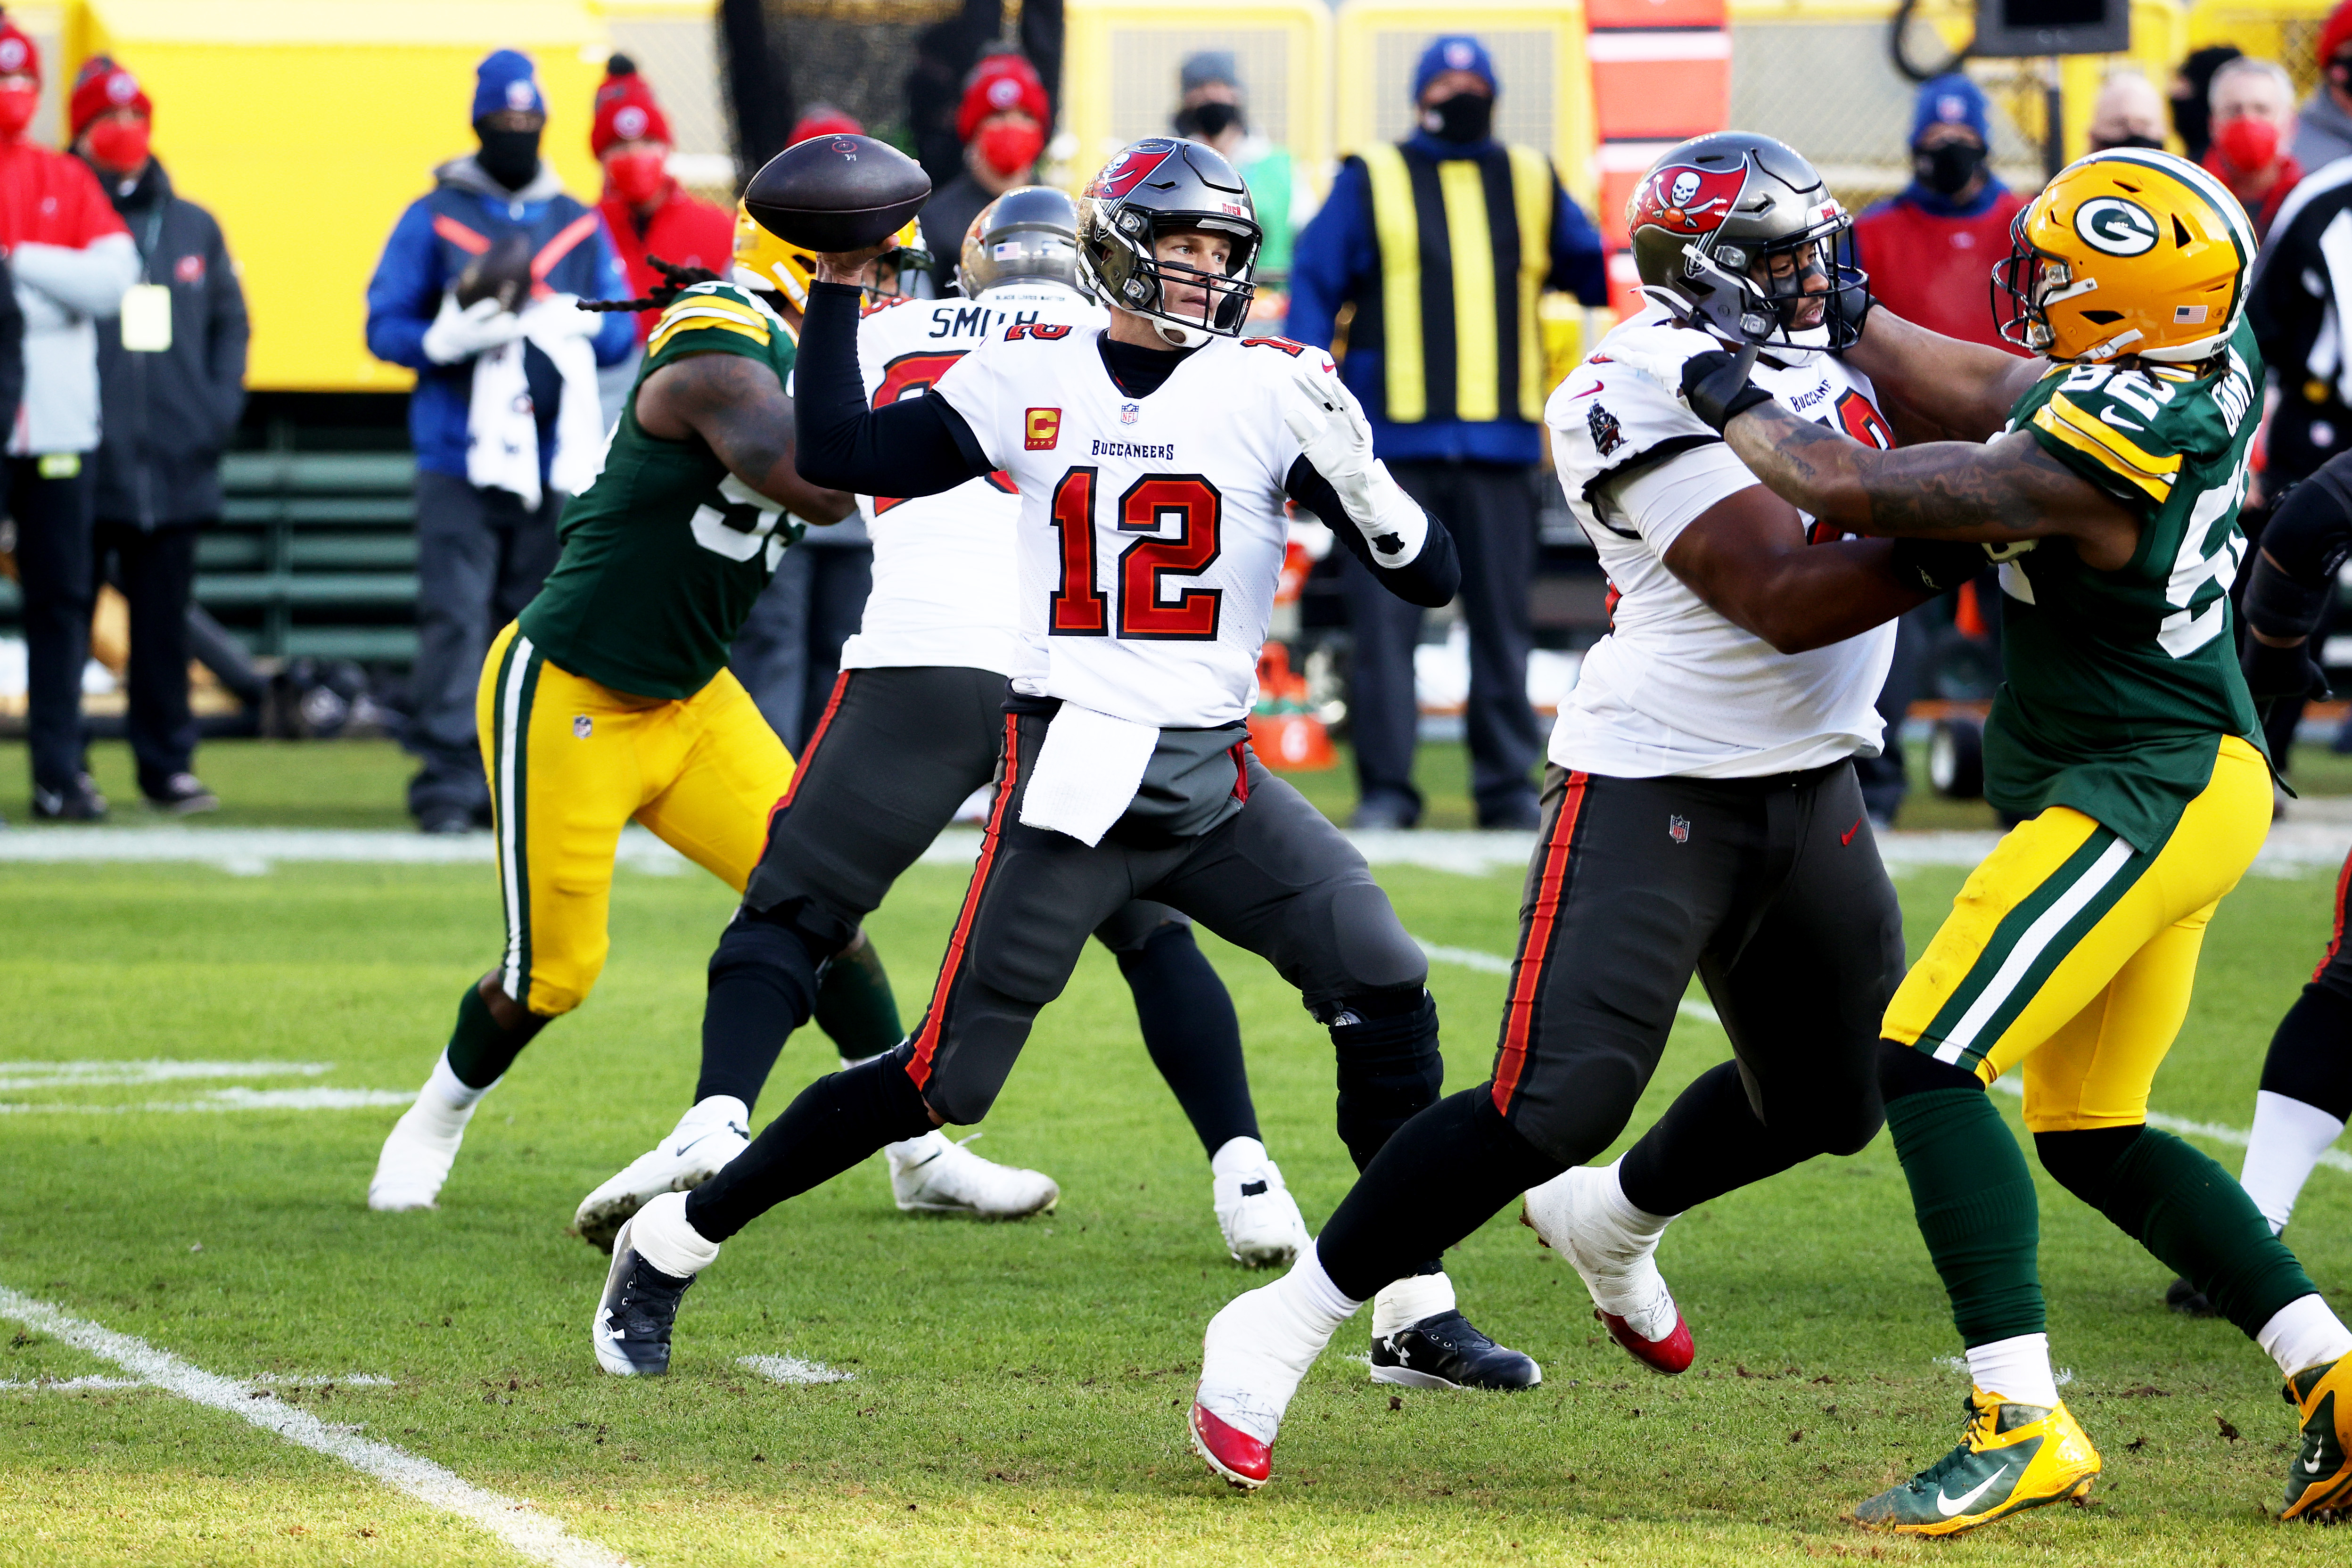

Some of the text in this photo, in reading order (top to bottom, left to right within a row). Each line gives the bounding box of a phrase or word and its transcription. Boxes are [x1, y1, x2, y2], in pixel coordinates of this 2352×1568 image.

[1790, 377, 1833, 412] BUCCANE
[1027, 410, 1058, 439] C
[1122, 412, 1136, 422] NFL
[1092, 440, 1174, 460] BUCCANEERS
[1049, 466, 1223, 641] 12
